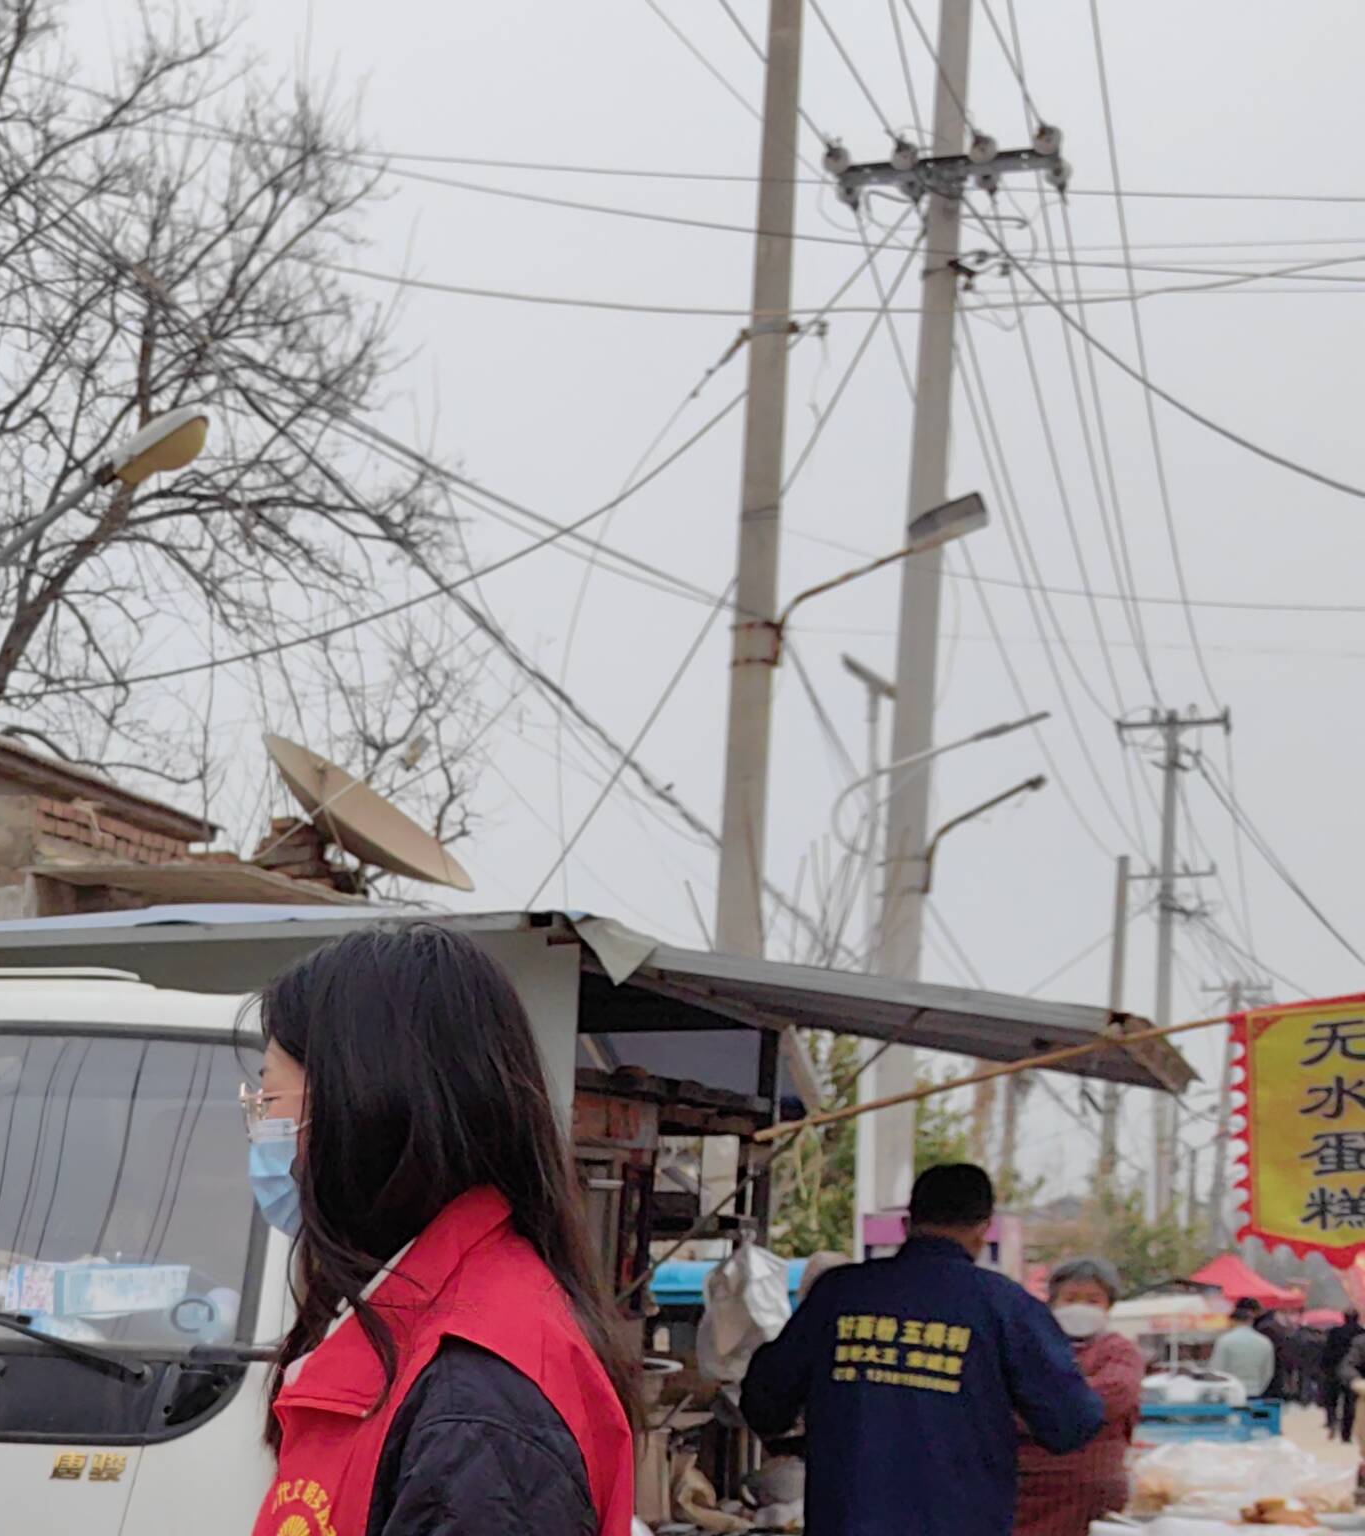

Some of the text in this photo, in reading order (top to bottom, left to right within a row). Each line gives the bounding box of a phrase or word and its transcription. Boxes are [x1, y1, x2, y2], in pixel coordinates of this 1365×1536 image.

[1299, 1018, 1365, 1231] 无水蛋糕
[49, 1452, 128, 1482] 唐骏
